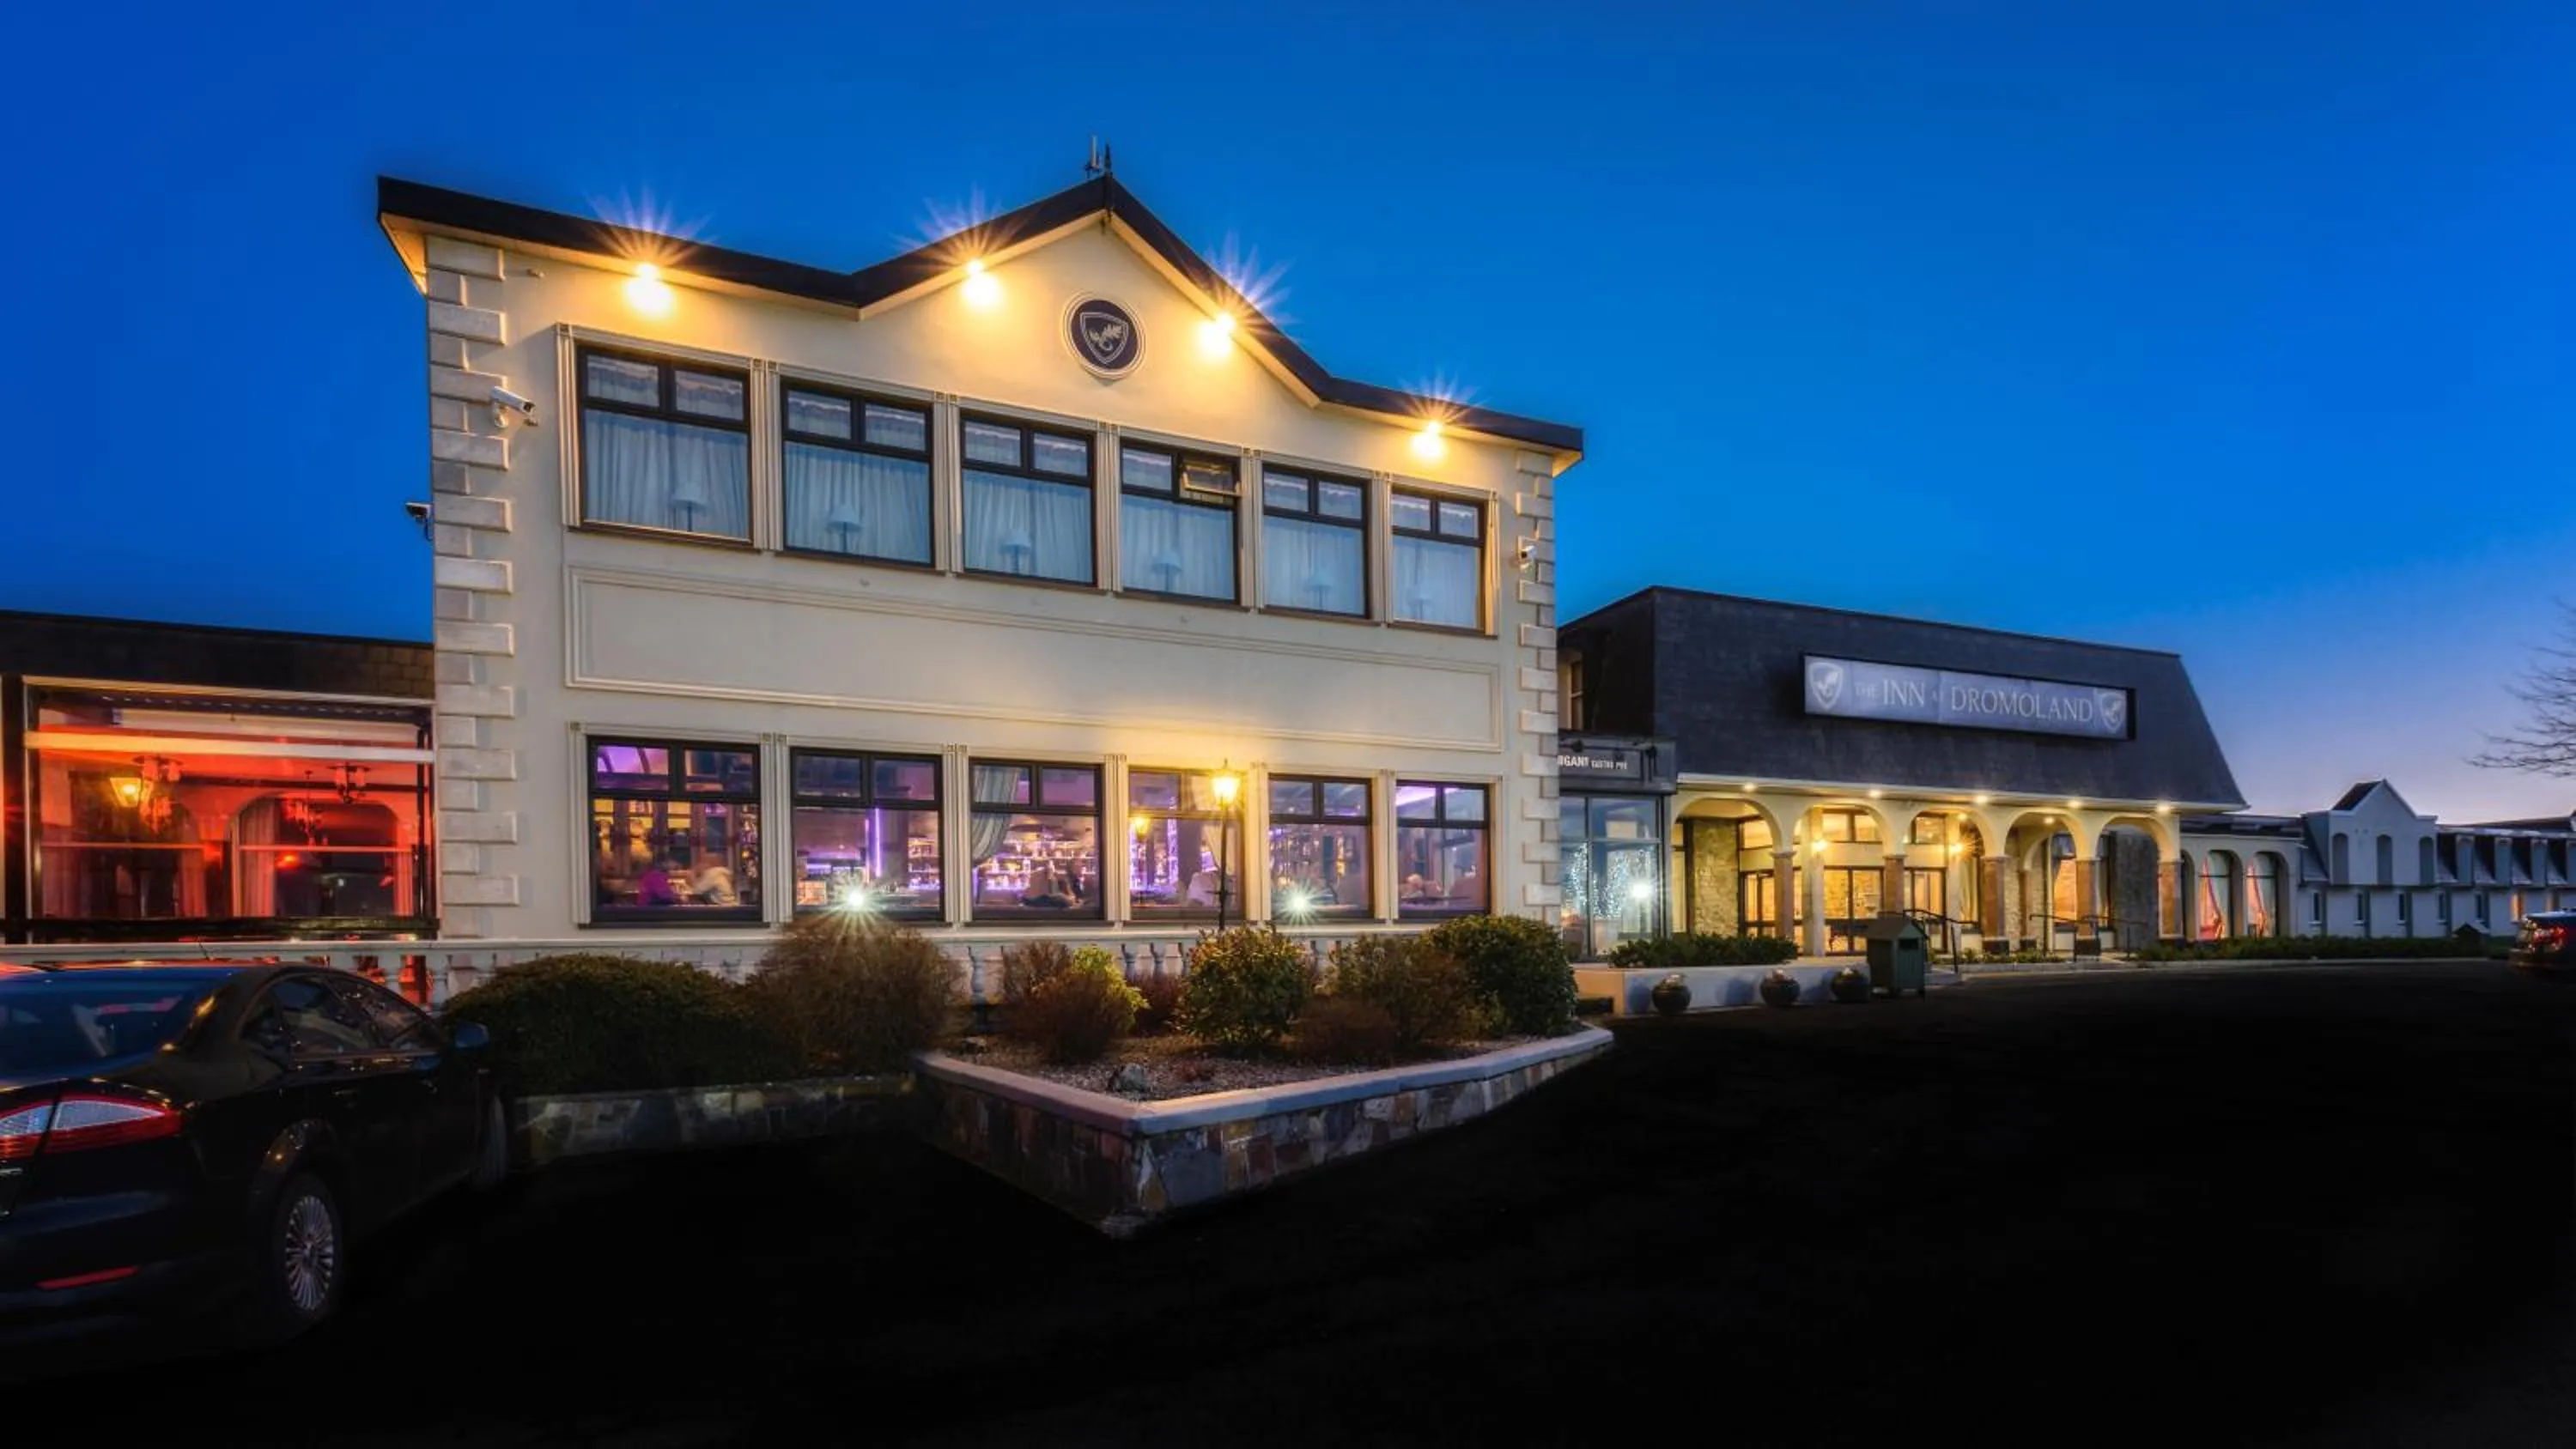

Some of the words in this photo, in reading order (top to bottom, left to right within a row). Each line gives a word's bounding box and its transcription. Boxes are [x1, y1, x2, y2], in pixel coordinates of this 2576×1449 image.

[1855, 682, 1878, 699] THE
[1883, 679, 1925, 707] INN
[1950, 686, 2093, 723] DROMOLAND
